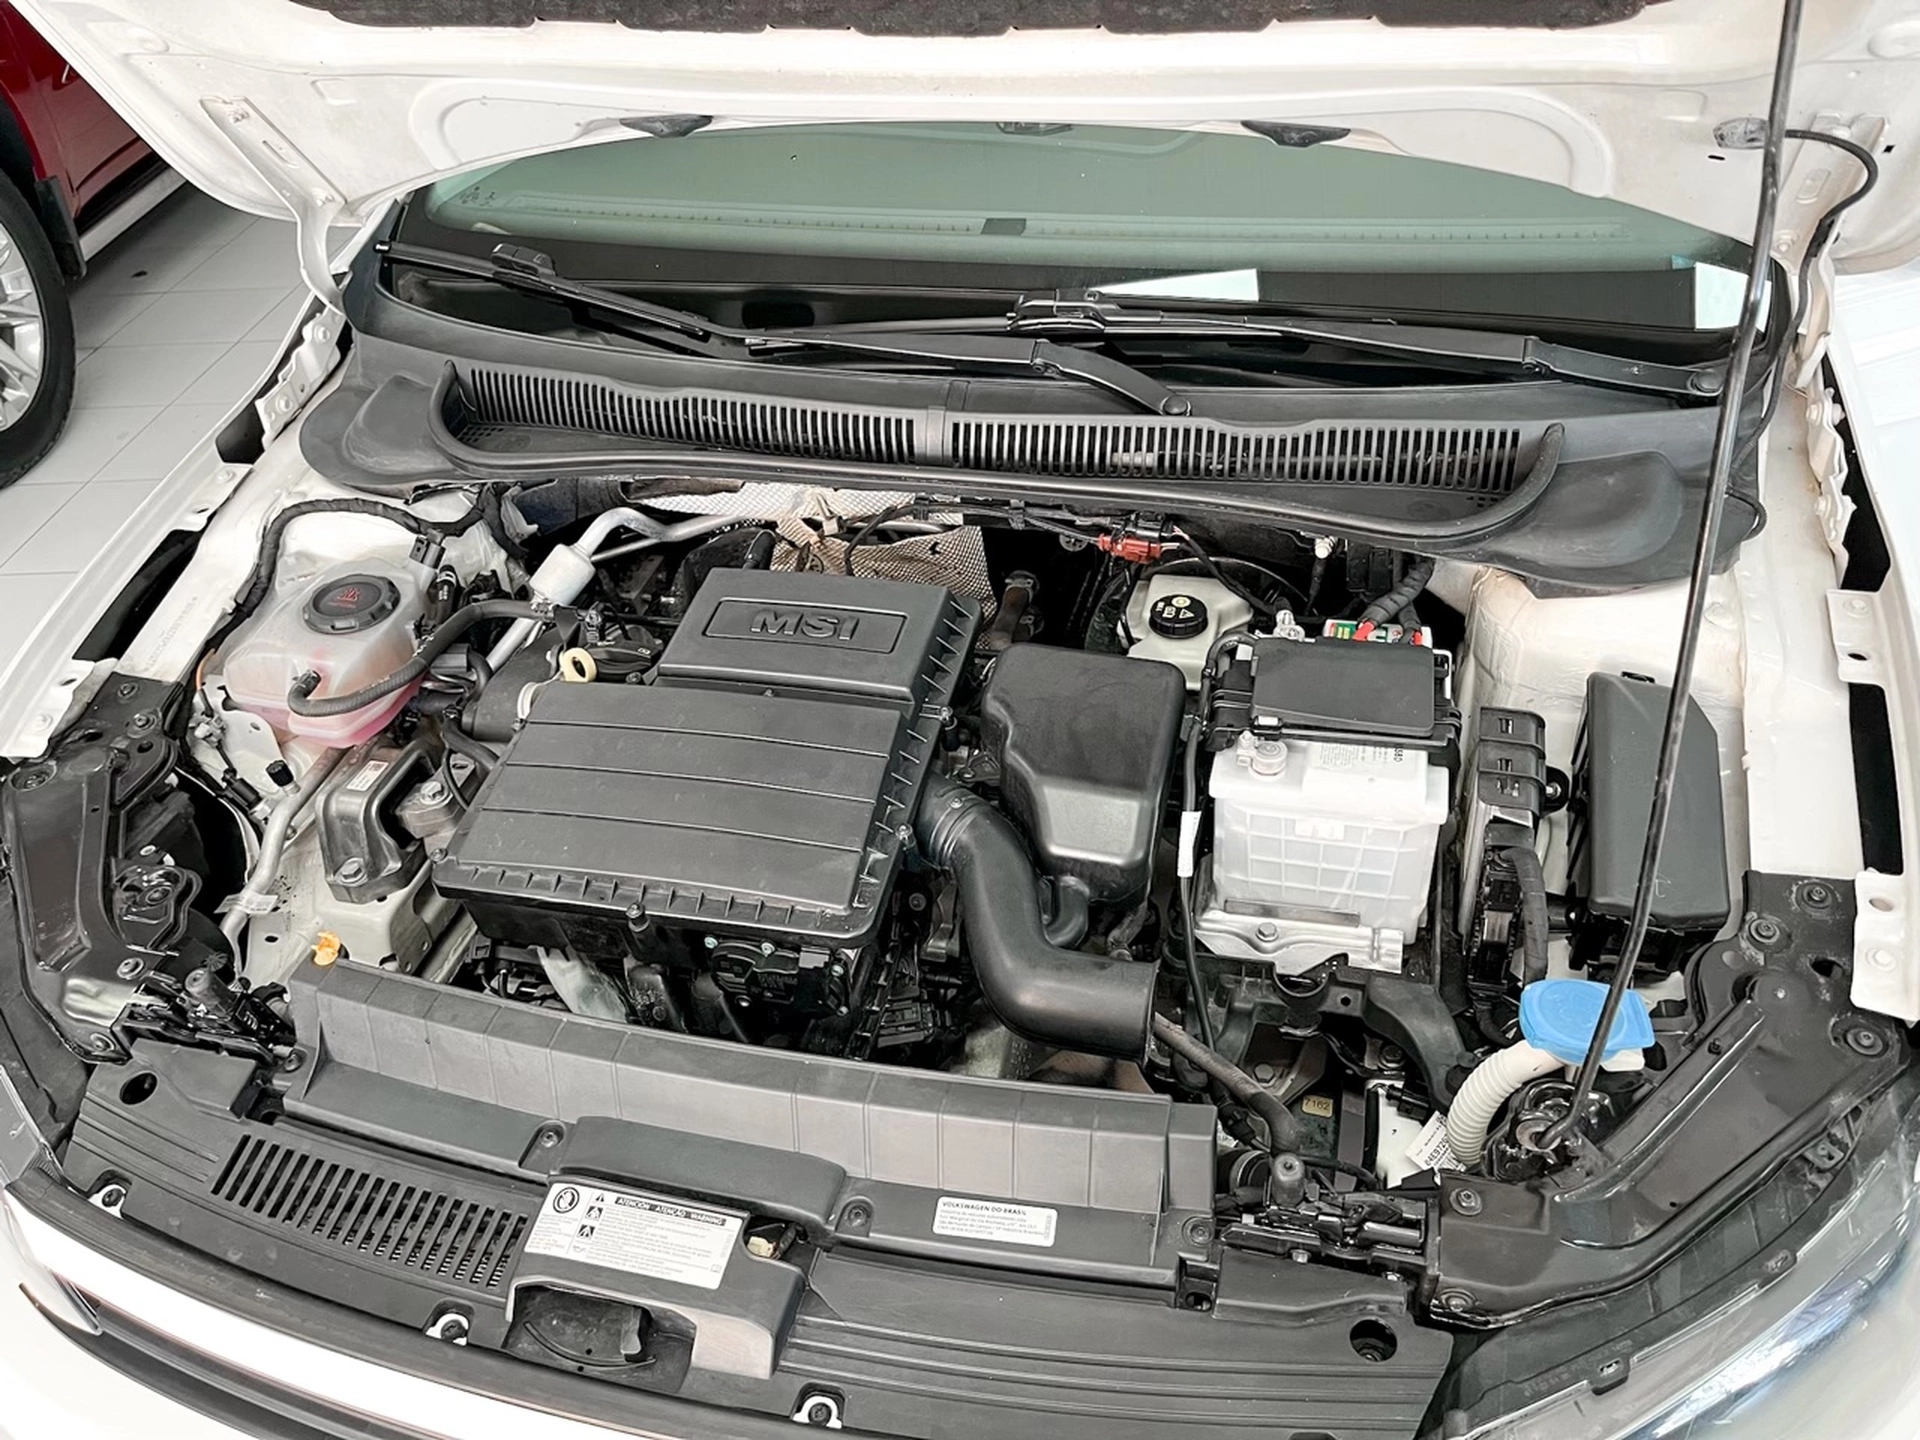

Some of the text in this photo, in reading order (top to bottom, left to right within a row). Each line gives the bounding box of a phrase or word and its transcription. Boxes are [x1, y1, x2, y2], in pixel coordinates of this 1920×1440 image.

[751, 609, 860, 641] MSI
[1304, 1097, 1330, 1111] 7162
[942, 1201, 990, 1212] VOLKSWAGEN
[1003, 1208, 1027, 1216] BRASIL
[690, 1212, 723, 1225] WARNING
